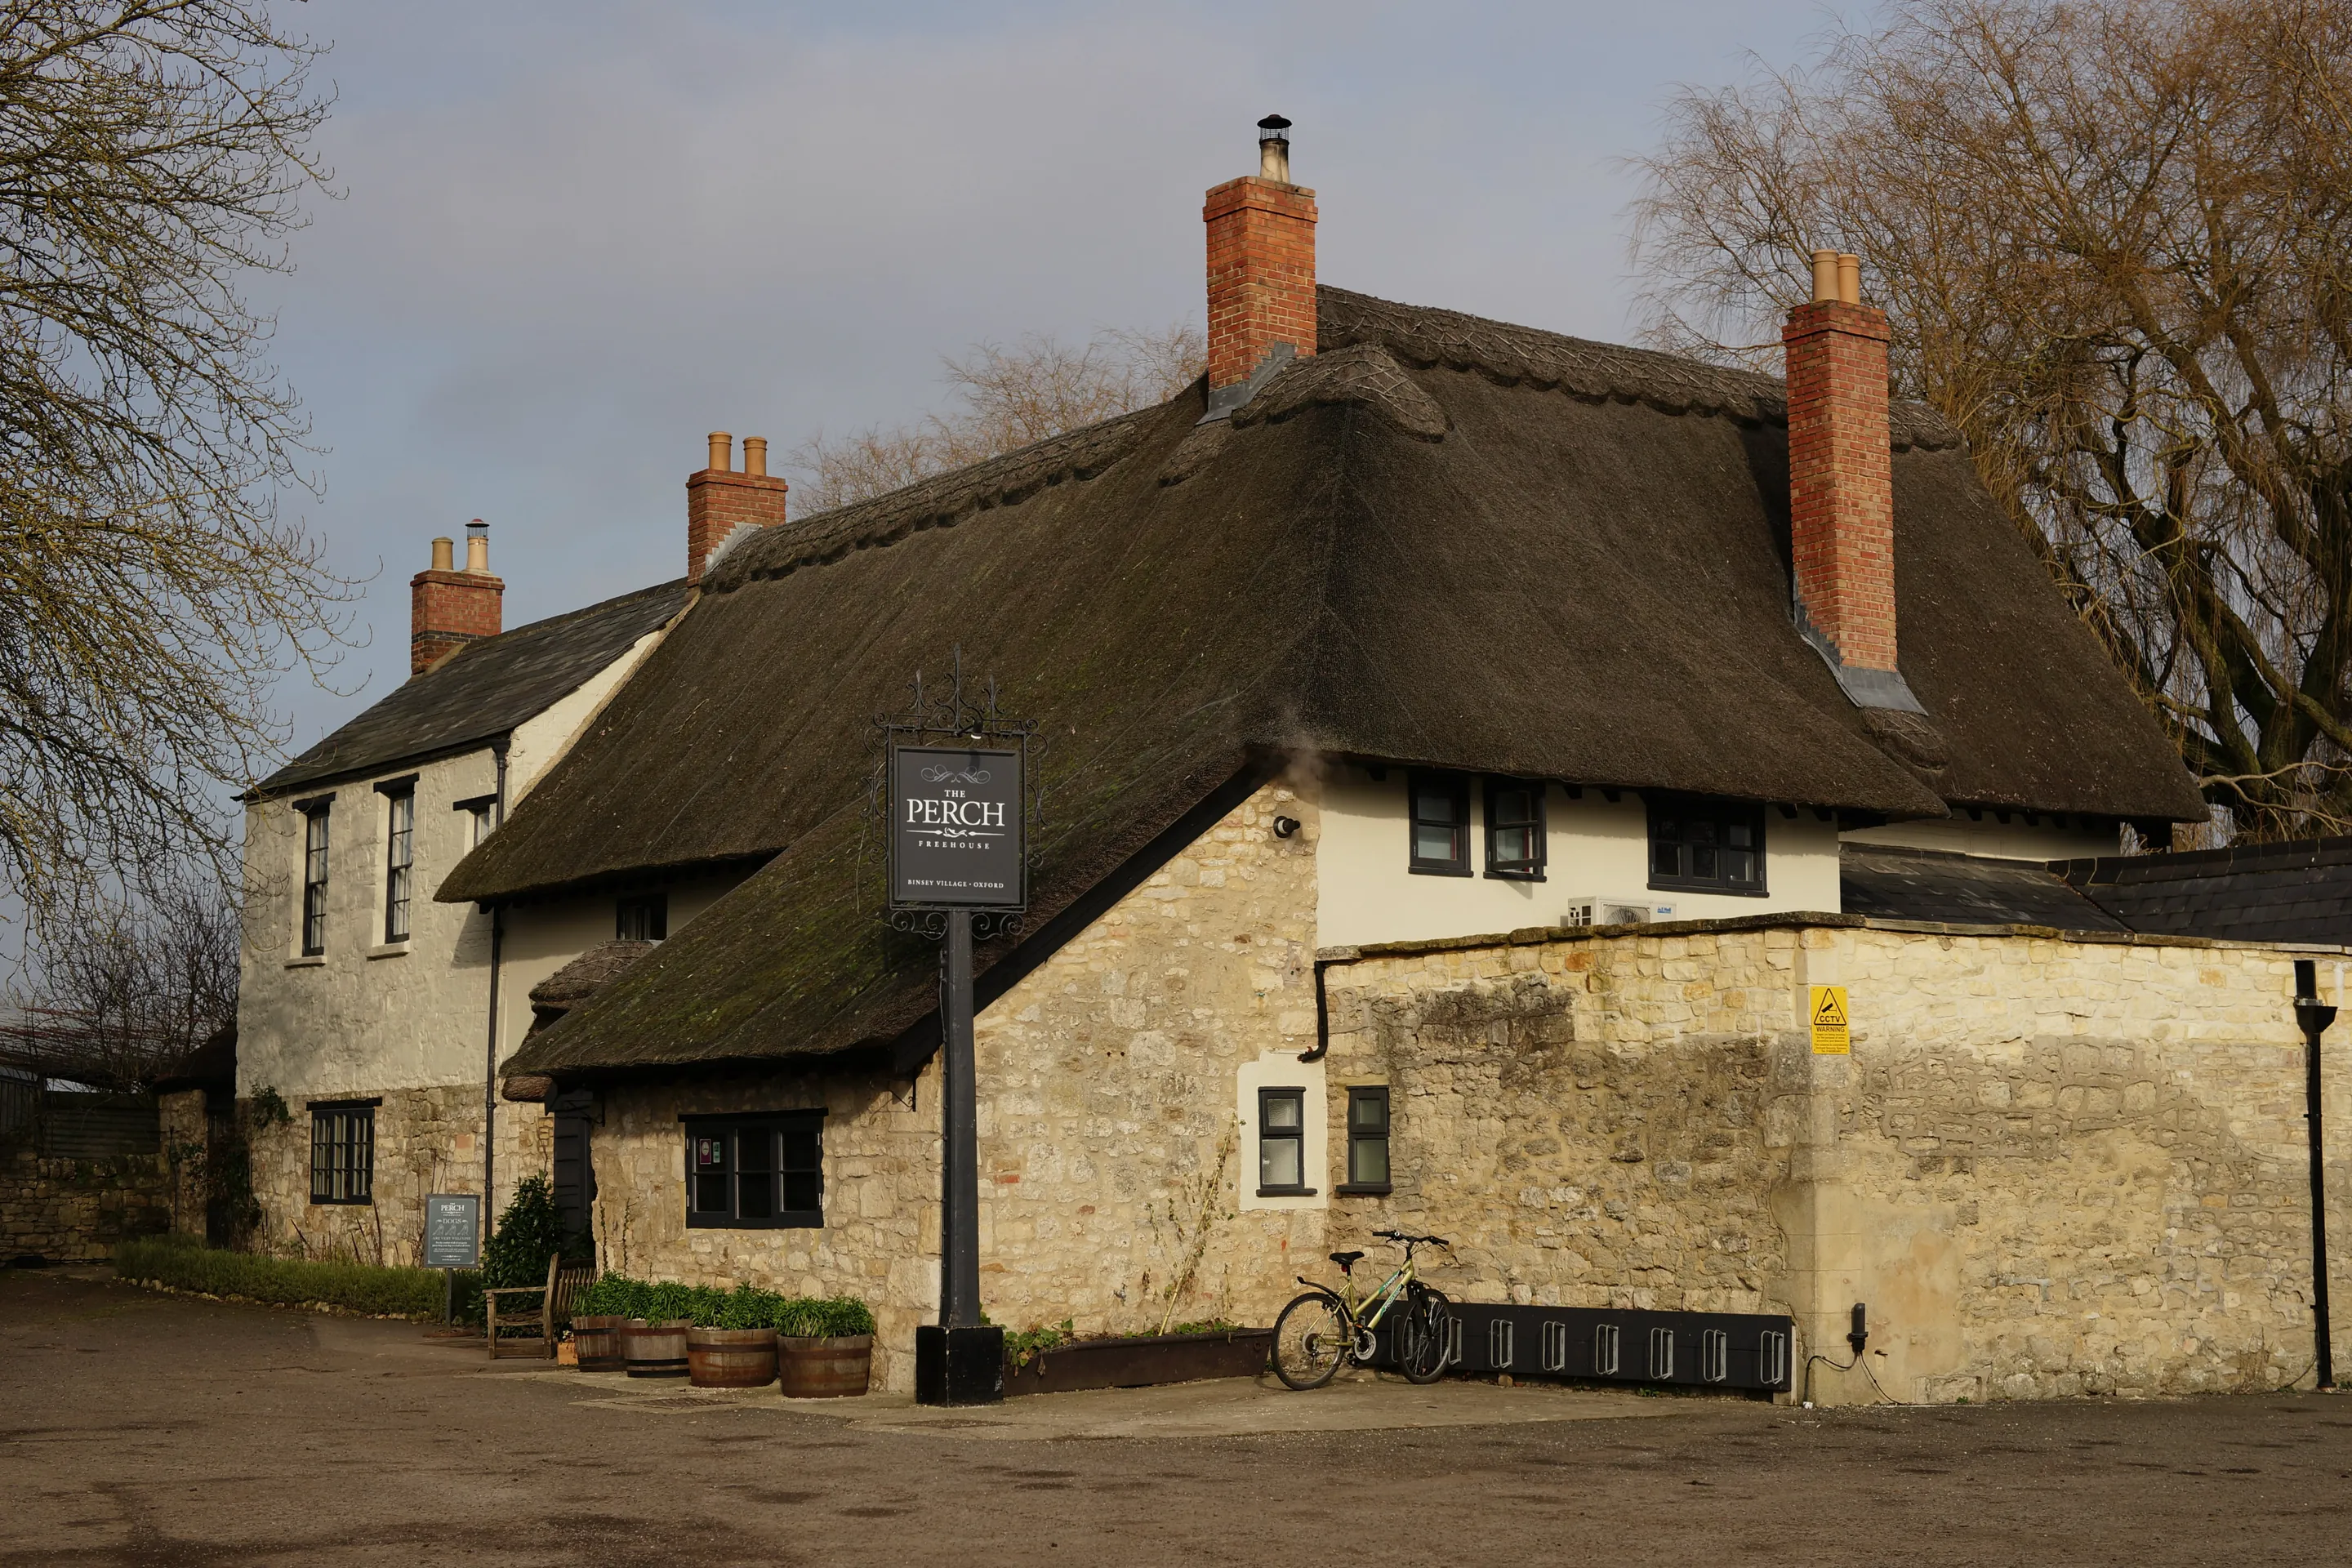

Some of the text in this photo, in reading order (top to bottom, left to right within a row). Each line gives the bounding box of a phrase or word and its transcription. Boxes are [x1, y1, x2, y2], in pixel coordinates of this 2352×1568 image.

[944, 790, 966, 798] THE
[906, 799, 1005, 826] PERCH
[918, 840, 990, 849] FREEHOUSE
